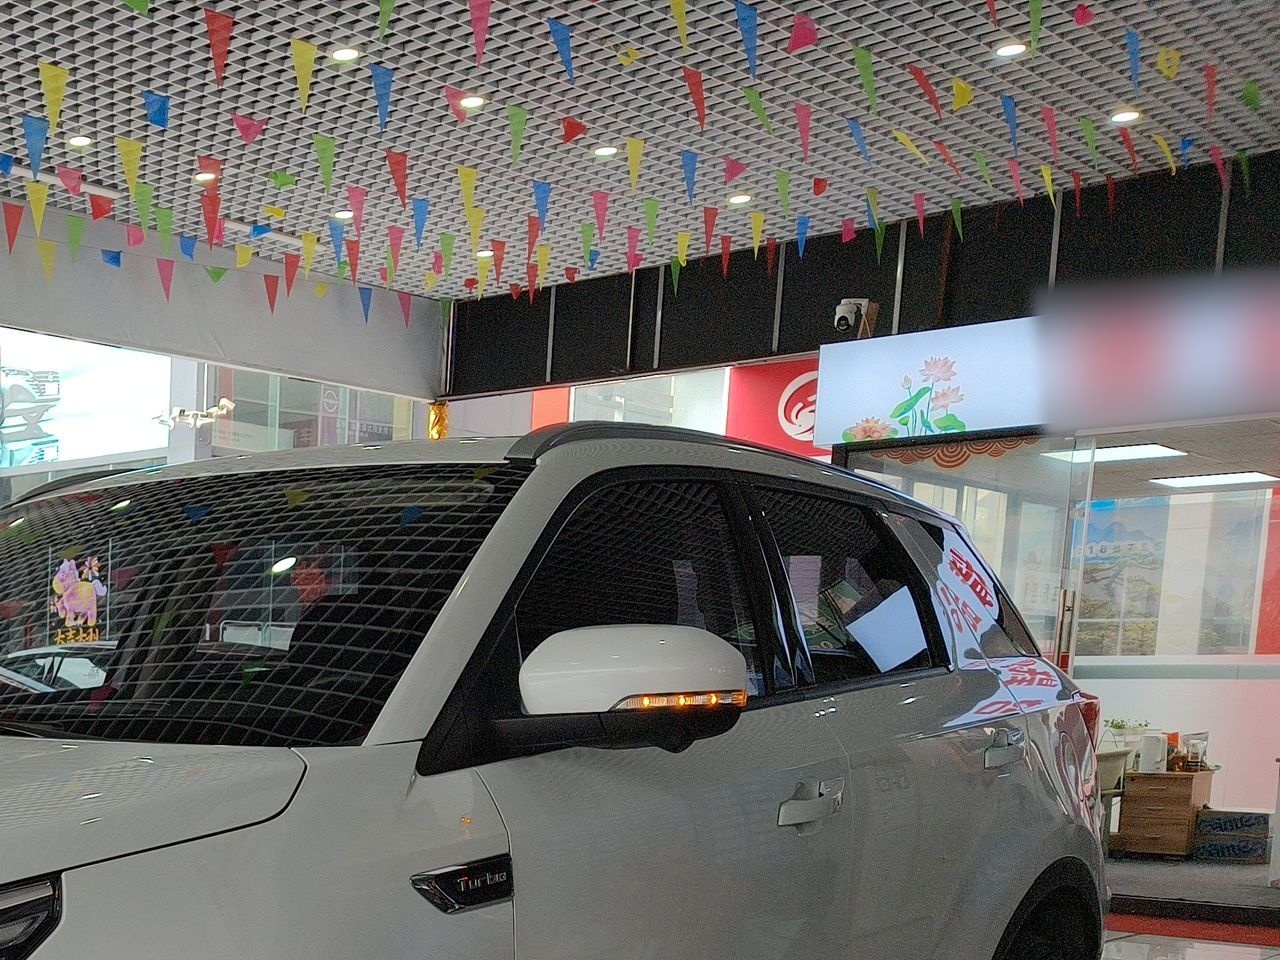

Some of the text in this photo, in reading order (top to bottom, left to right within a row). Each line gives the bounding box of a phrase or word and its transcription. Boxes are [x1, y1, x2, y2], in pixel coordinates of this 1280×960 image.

[54, 627, 100, 645] 大吉大利
[457, 871, 508, 892] Turbo
